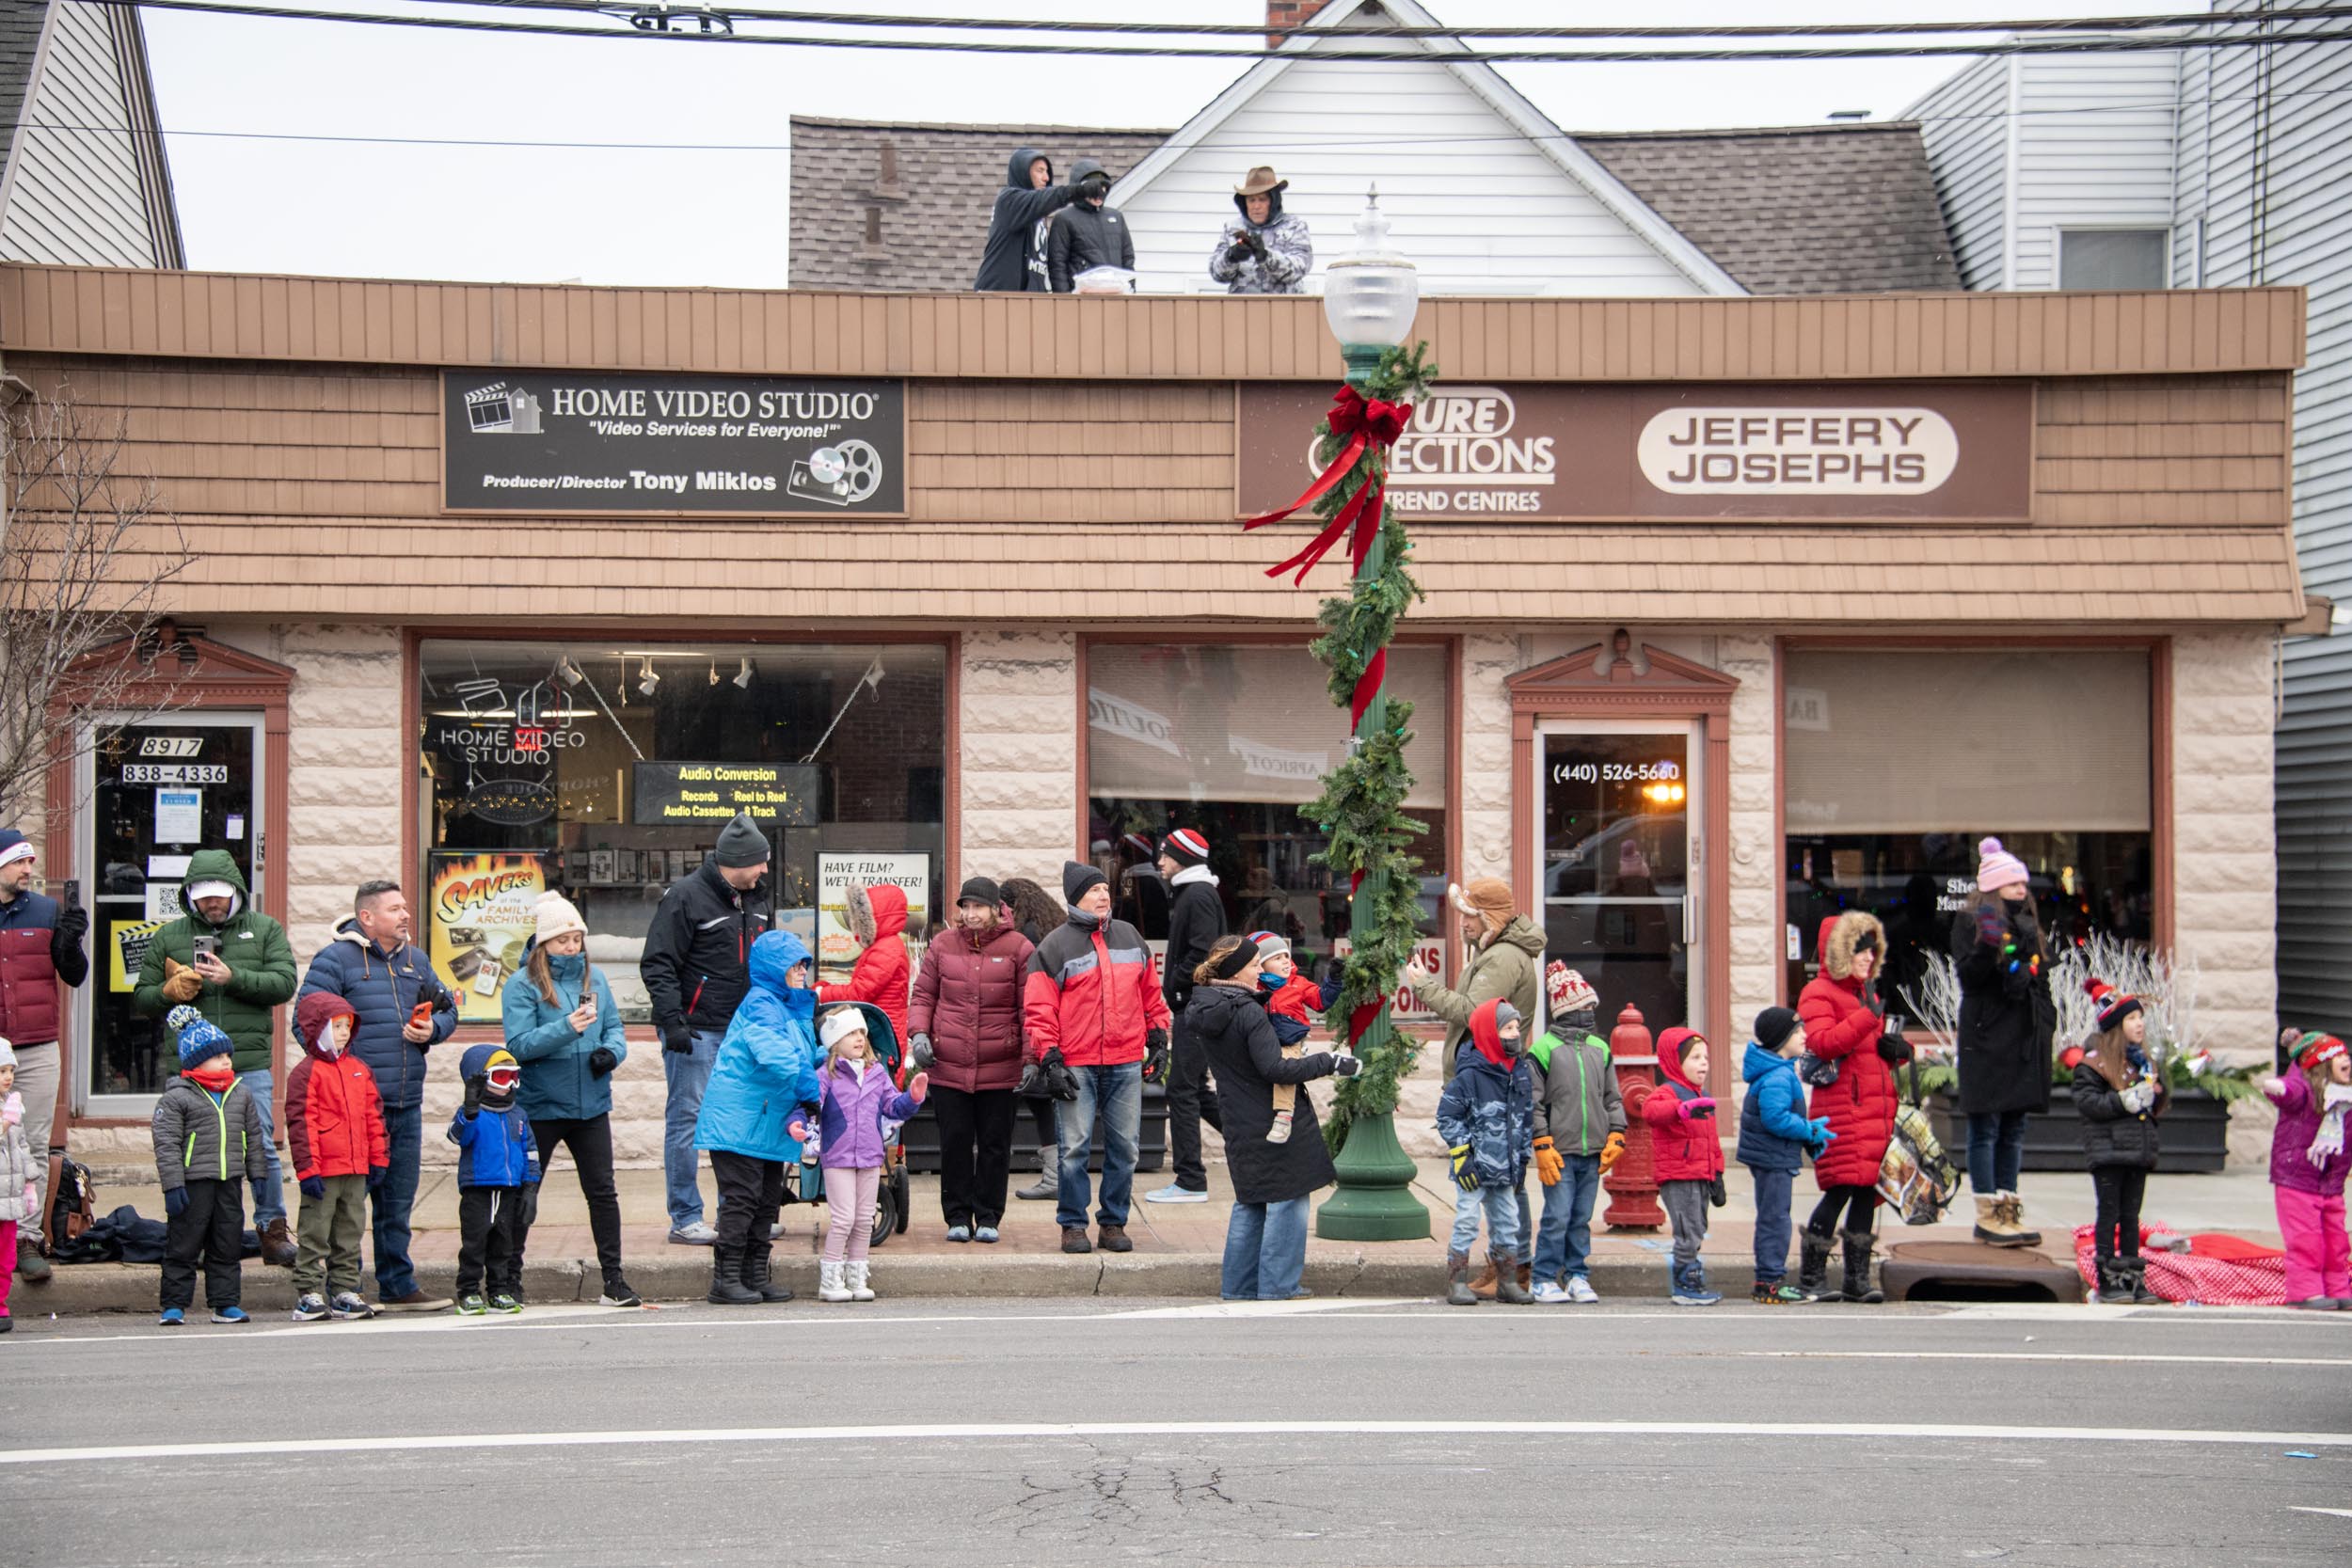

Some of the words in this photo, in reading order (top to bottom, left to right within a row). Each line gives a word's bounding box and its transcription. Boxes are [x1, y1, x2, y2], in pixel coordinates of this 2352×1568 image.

[552, 388, 646, 417] HOME
[653, 390, 751, 418] VIDEO
[589, 420, 643, 436] "Video
[646, 421, 717, 436] Services
[721, 423, 743, 437] for
[1668, 418, 1923, 446] JEFFERY
[1668, 453, 1925, 483] JOSEPHS
[483, 474, 627, 489] Producer/Director
[629, 470, 688, 493] Tony
[696, 471, 777, 491] Miklos
[1384, 491, 1449, 511] TREND
[1454, 491, 1541, 512] CENTRES
[143, 739, 201, 754] 8917
[440, 729, 509, 746] HOME
[515, 730, 586, 748] VIDEO
[466, 747, 550, 766] STUDIO
[124, 766, 226, 782] 838-4336
[678, 767, 712, 781] Audio
[714, 767, 777, 781] Conversion
[1553, 764, 1597, 784] (440)
[1602, 763, 1679, 781] 526-5660
[681, 790, 719, 802] Records
[735, 790, 754, 802] Reel
[755, 792, 765, 802] to
[767, 791, 787, 802] Reel
[664, 805, 691, 816] Audio
[692, 805, 736, 817] Cassettes
[744, 806, 751, 816] 8
[752, 806, 776, 817] Track
[824, 863, 854, 873] HAVE
[858, 863, 894, 873] FILM?
[862, 877, 923, 887] TRANSFER!
[1947, 878, 1978, 894] She
[437, 871, 534, 923] SAVERS
[486, 905, 530, 915] FAMILY
[476, 915, 538, 925] ARCHIVES
